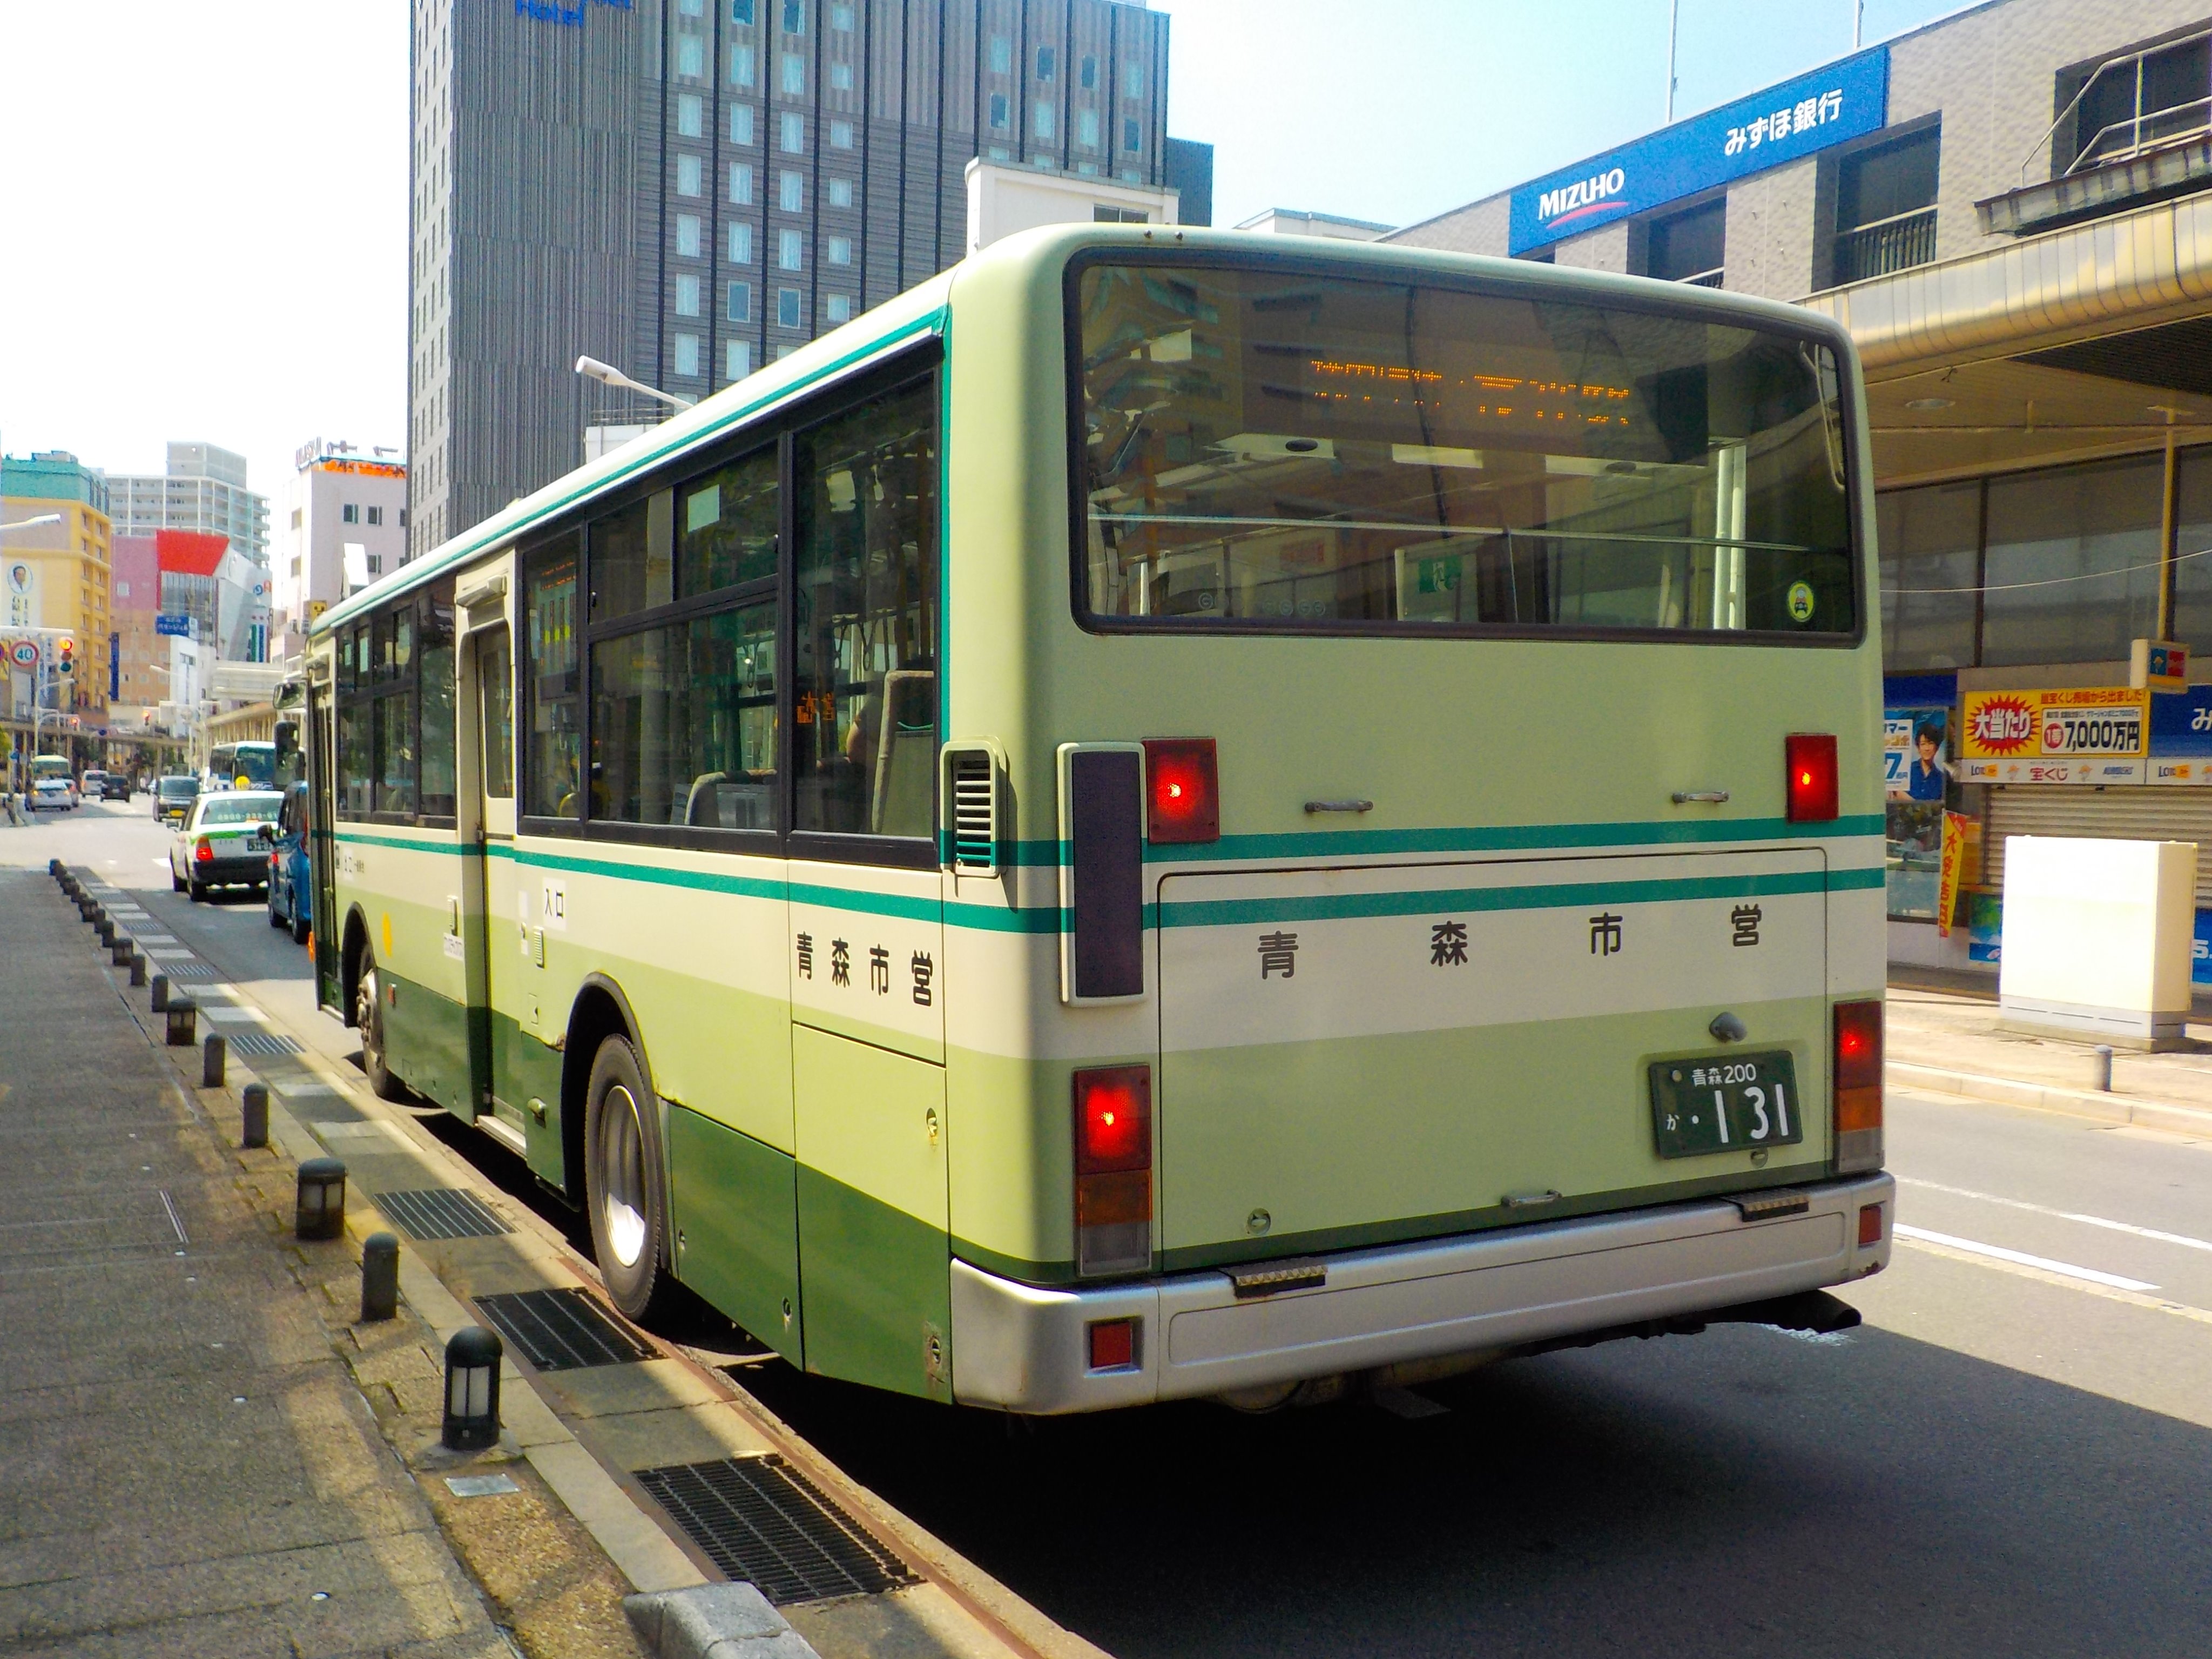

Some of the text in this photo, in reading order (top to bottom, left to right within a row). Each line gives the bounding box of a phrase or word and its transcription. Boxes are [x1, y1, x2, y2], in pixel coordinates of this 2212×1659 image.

[1724, 88, 1843, 156] みずほ銀行
[1538, 168, 1625, 221] MIZUHO
[17, 648, 33, 660] 40
[1975, 708, 2032, 740] 大当たり
[2065, 720, 2141, 752] 7,000万円
[2029, 767, 2068, 781] 宝くじ
[544, 887, 564, 919] 入口
[1257, 903, 1762, 980] 青森市営
[797, 930, 933, 1007] 青森市営
[1666, 1113, 1680, 1131] か
